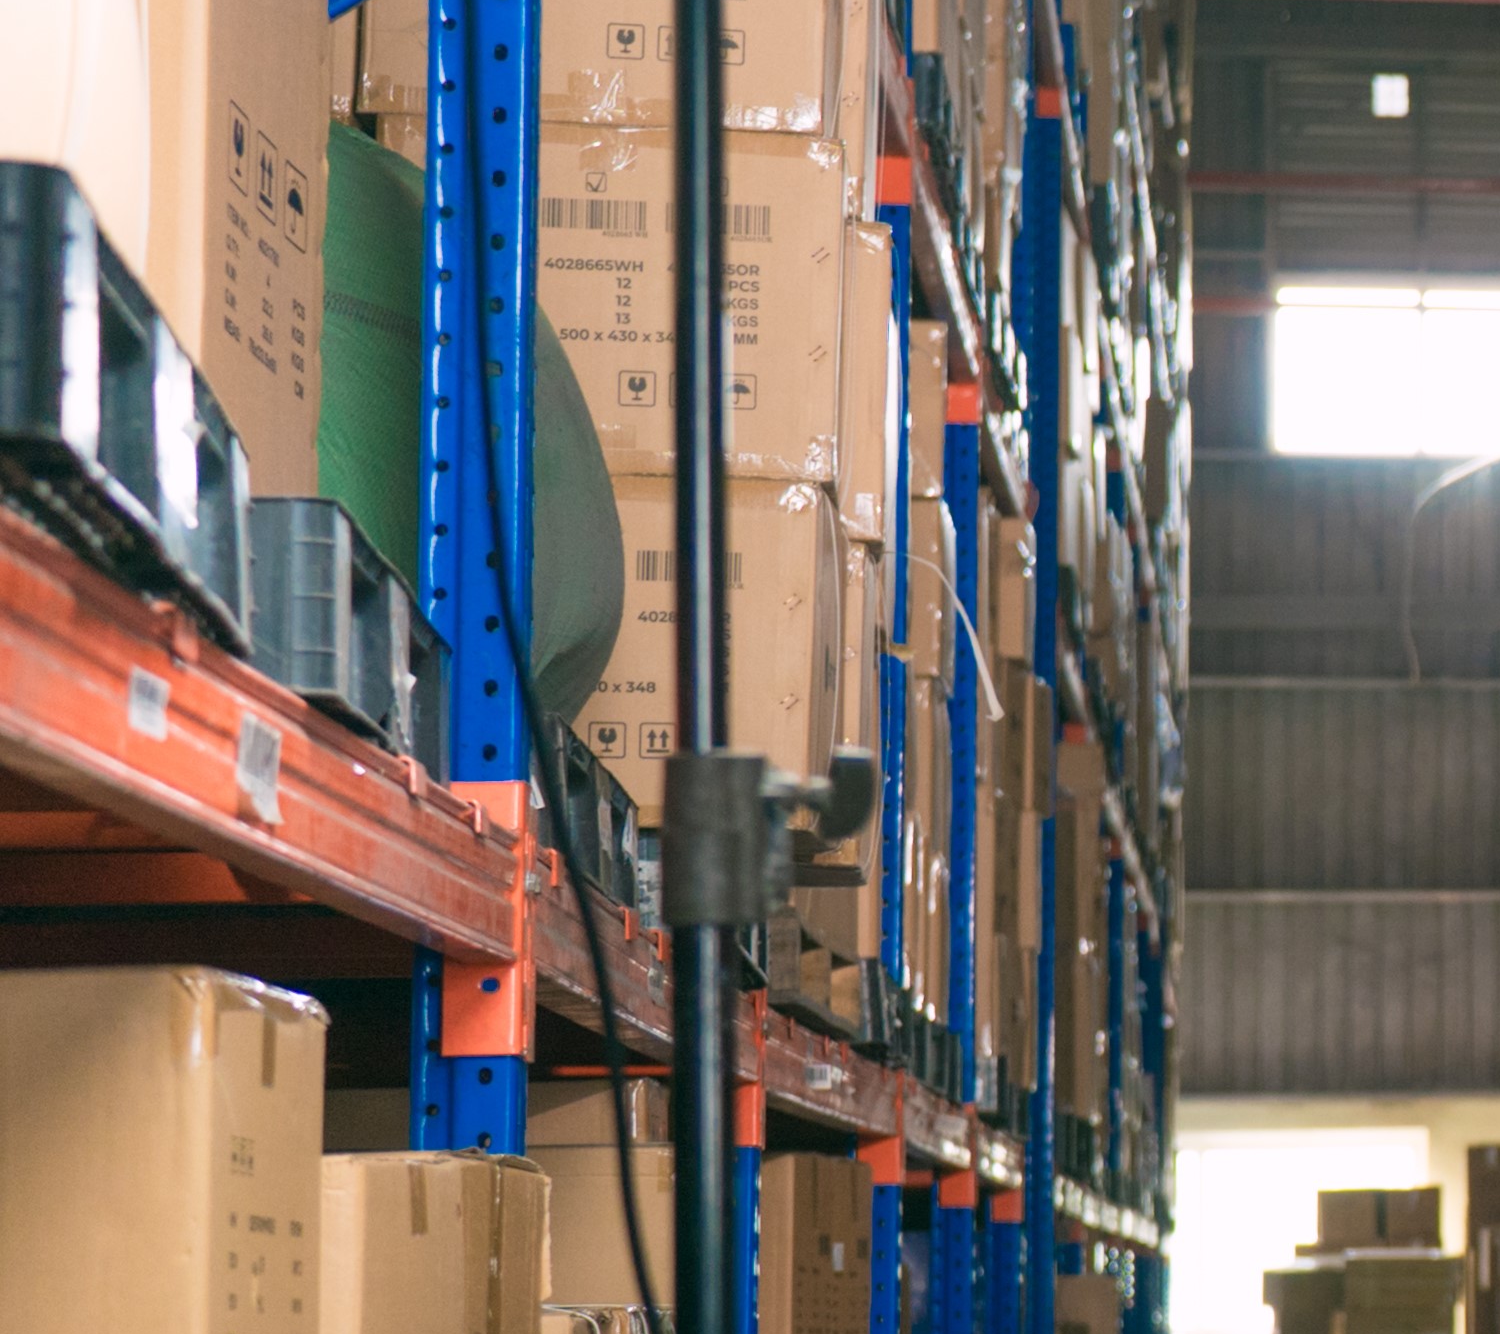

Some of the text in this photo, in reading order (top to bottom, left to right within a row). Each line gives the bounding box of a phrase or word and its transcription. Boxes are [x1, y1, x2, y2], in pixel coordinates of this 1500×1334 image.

[544, 258, 644, 273] 4028665WH
[616, 277, 760, 293] 12 PCS
[616, 295, 631, 307] 12
[616, 312, 631, 325] 13
[560, 328, 758, 345] 500 x 430 x 34 MM
